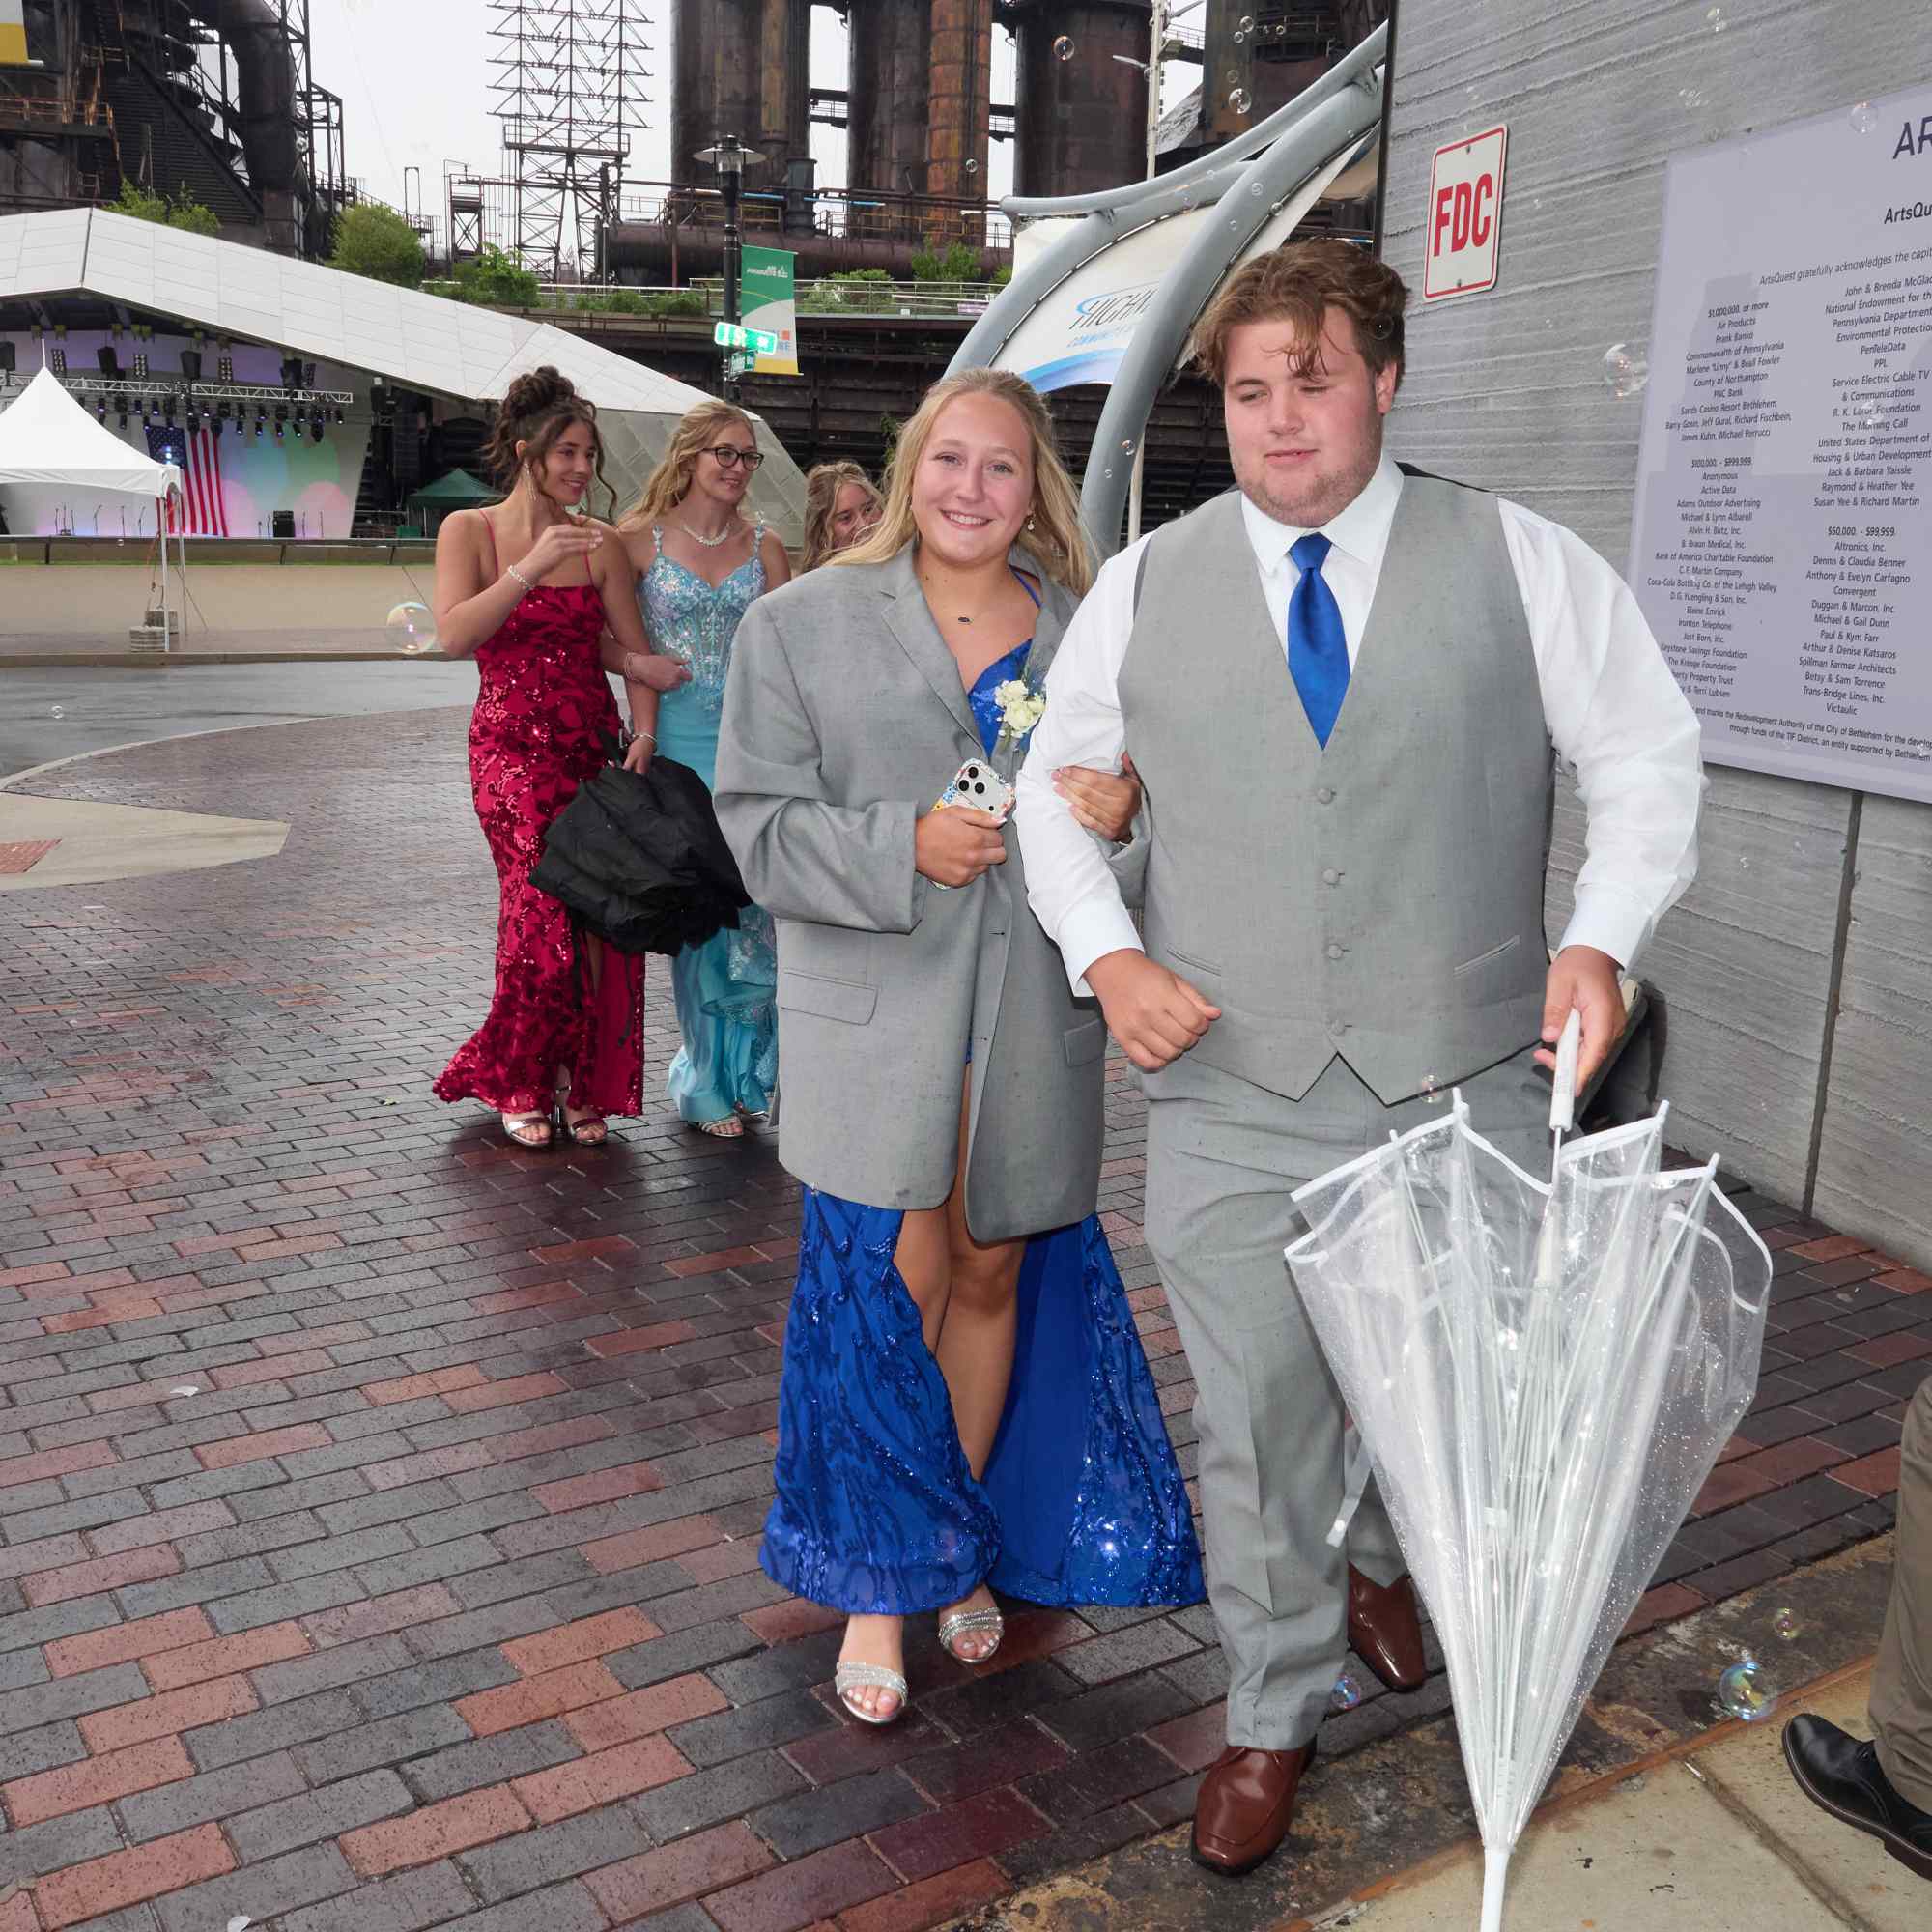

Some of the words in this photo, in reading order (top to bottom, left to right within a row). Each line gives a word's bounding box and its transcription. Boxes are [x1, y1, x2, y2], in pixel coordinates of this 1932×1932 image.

[1434, 173, 1492, 257] FDC
[1797, 265, 1833, 281] gratefully
[1835, 256, 1891, 272] acknowledges
[1895, 251, 1909, 263] the
[1845, 286, 1862, 297] John
[1864, 284, 1871, 293] &
[1874, 280, 1901, 292] Brenda
[1826, 301, 1856, 315] National
[1859, 296, 1905, 309] Endowment
[1909, 293, 1919, 301] for
[1717, 322, 1726, 330] Air
[1728, 317, 1756, 327] Products
[1833, 315, 1881, 327] Pennsylvania
[1716, 333, 1732, 344] Frank
[1836, 327, 1891, 342] Environmental
[1686, 348, 1733, 361] Commonwealth
[1734, 346, 1742, 355] of
[1743, 342, 1784, 354] Pennsylvania
[1861, 342, 1906, 355] PenTeleData
[1874, 358, 1888, 368] PPL
[1725, 373, 1768, 384] Northampton
[1833, 379, 1859, 387] Service
[1861, 375, 1889, 384] Electric
[1893, 371, 1916, 382] Cable
[1918, 370, 1930, 379] TV
[1841, 392, 1848, 402] &
[1851, 388, 1915, 401] Communications
[1699, 405, 1719, 413] Casino
[1720, 403, 1741, 412] Resort
[1743, 400, 1777, 410] Bethlehem
[1876, 402, 1920, 413] Foundation
[1735, 415, 1758, 424] Richard
[1842, 421, 1856, 431] The
[1859, 421, 1890, 431] Morning
[1893, 417, 1908, 429] Call
[1719, 430, 1743, 439] Michael
[1818, 439, 1842, 447] United
[1845, 437, 1866, 446] States
[1870, 435, 1918, 446] Department
[1920, 433, 1930, 442] of
[1813, 454, 1842, 464] Housing
[1844, 452, 1850, 462] &
[1853, 452, 1876, 461] Urban
[1879, 448, 1932, 461] Development
[1702, 472, 1738, 481] Anonymous
[1828, 468, 1842, 477] Jack
[1845, 468, 1851, 476] &
[1854, 468, 1884, 476] Barbara
[1822, 481, 1857, 494] Raymond
[1859, 482, 1864, 491] &
[1867, 481, 1897, 491] Heather
[1724, 498, 1761, 509] Advertising
[1814, 497, 1835, 506] Susan
[1852, 497, 1858, 506] &
[1861, 497, 1889, 506] Richard
[1892, 497, 1919, 506] Martin
[1828, 526, 1857, 536] $50,000
[1865, 526, 1895, 537] $99,999
[1872, 542, 1886, 552] Inc.
[1678, 553, 1702, 561] America
[1704, 553, 1735, 562] Charitable
[1737, 554, 1773, 564] Foundation
[1813, 556, 1836, 565] Dennis
[1839, 556, 1845, 565] &
[1848, 556, 1875, 566] Claudia
[1878, 557, 1906, 568] Benner
[1714, 567, 1743, 578] Company
[1806, 570, 1837, 582] Anthony
[1848, 572, 1871, 583] Evelyn
[1647, 578, 1675, 586] Coca-Cola
[1714, 581, 1720, 589] of
[1735, 581, 1756, 593] Lehigh
[1758, 582, 1777, 593] Valley
[1833, 585, 1876, 598] Convergent
[1685, 593, 1712, 604] Yuengling
[1812, 599, 1839, 611] Duggan
[1842, 601, 1847, 611] &
[1702, 620, 1731, 631] Telephone
[1814, 614, 1843, 624] Michael
[1844, 616, 1850, 625] &
[1853, 617, 1866, 626] Gail
[1820, 630, 1835, 639] Paul
[1838, 631, 1843, 639] &
[1846, 632, 1861, 642] Kym
[1713, 648, 1747, 659] Foundation
[1803, 642, 1827, 652] Arthur
[1837, 645, 1861, 656] Denise
[1864, 648, 1896, 659] Katsaros
[1702, 661, 1737, 671] Foundation
[1799, 657, 1828, 667] Spillman
[1830, 660, 1855, 669] Farmer
[1858, 663, 1897, 674] Architects
[1690, 672, 1716, 684] Property
[1719, 675, 1733, 685] Trust
[1805, 671, 1825, 684] Betsy
[1835, 674, 1851, 684] Sam
[1855, 676, 1886, 688] Torrence
[1804, 685, 1847, 700] Trans-Bridge
[1827, 703, 1858, 715] Victaulic
[1779, 719, 1805, 730] Authority
[1826, 724, 1838, 735] City
[1884, 732, 1893, 742] for
[1895, 734, 1906, 744] the
[1851, 744, 1884, 754] supported
[1885, 748, 1893, 757] by
